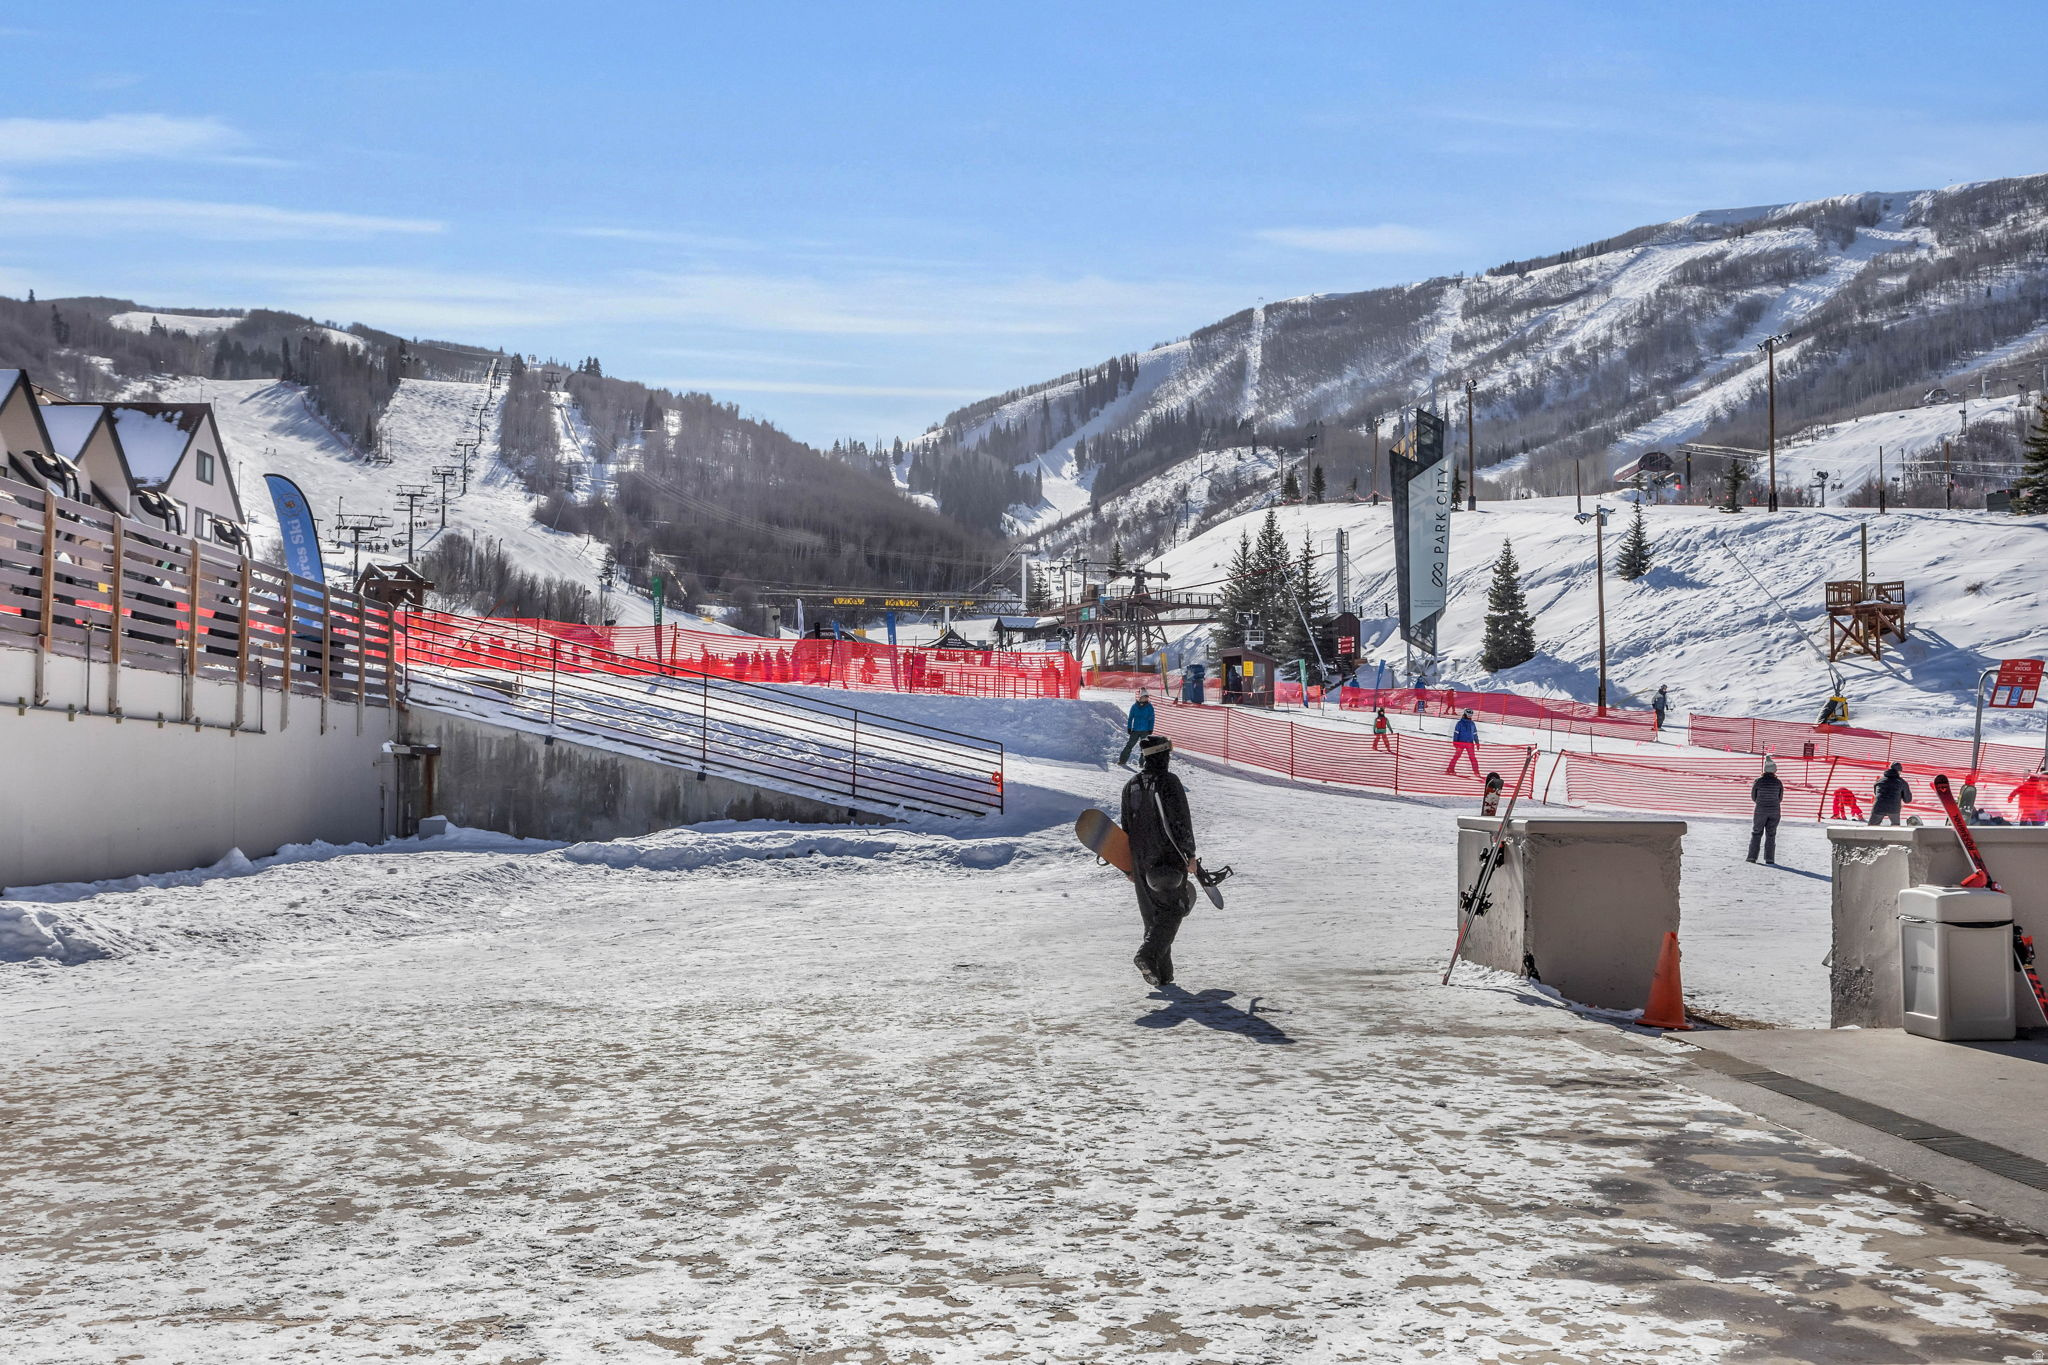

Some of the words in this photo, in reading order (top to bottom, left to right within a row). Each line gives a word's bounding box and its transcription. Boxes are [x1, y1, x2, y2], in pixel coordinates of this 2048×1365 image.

[1436, 468, 1449, 506] CITY
[287, 519, 305, 545] Ski
[1434, 513, 1447, 554] PARK
[1953, 814, 1976, 852] ROSSIGNOL
